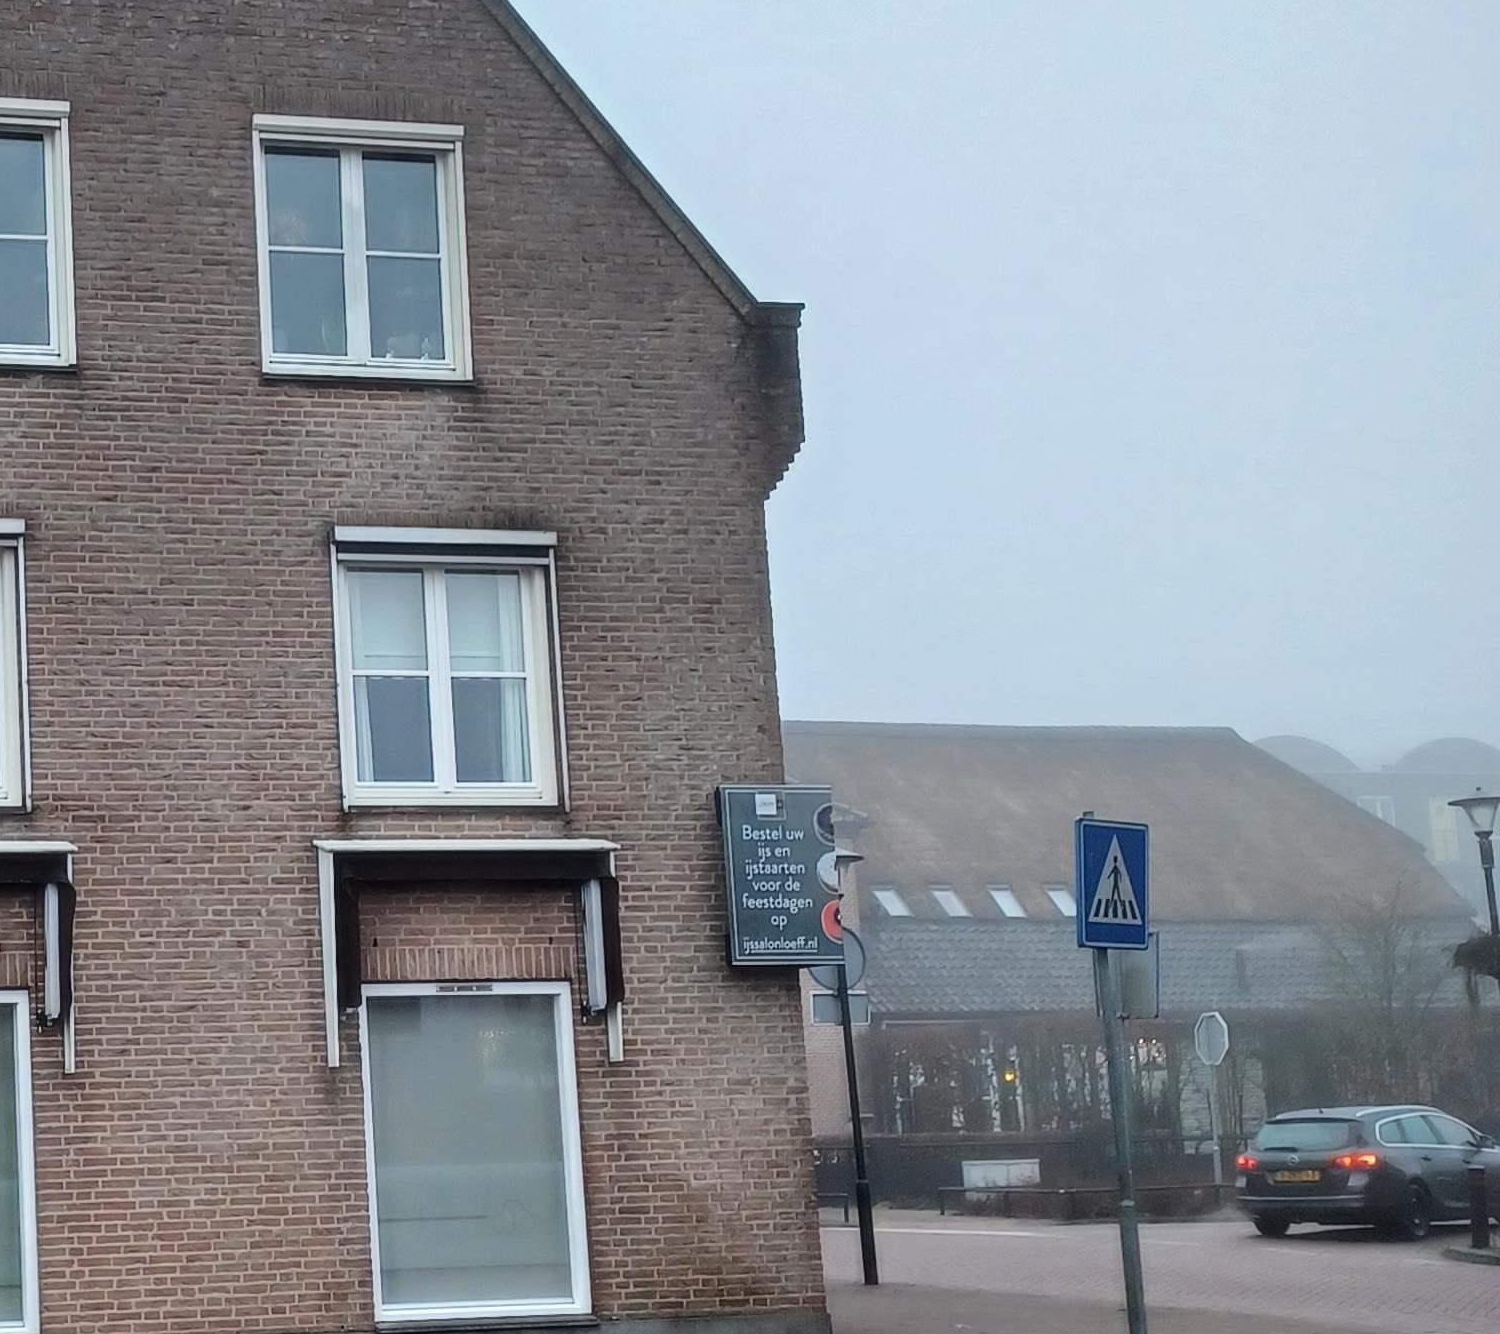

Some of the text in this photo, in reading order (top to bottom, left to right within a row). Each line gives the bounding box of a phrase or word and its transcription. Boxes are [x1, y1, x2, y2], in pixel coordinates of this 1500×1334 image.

[742, 825, 805, 841] Bestel uw
[757, 843, 791, 862] ijs en
[745, 860, 806, 880] ijstaarten
[751, 877, 801, 892] voor de
[742, 893, 814, 915] feestdagen
[770, 915, 788, 931] op
[743, 936, 818, 954] ijssalonloeff.nl
